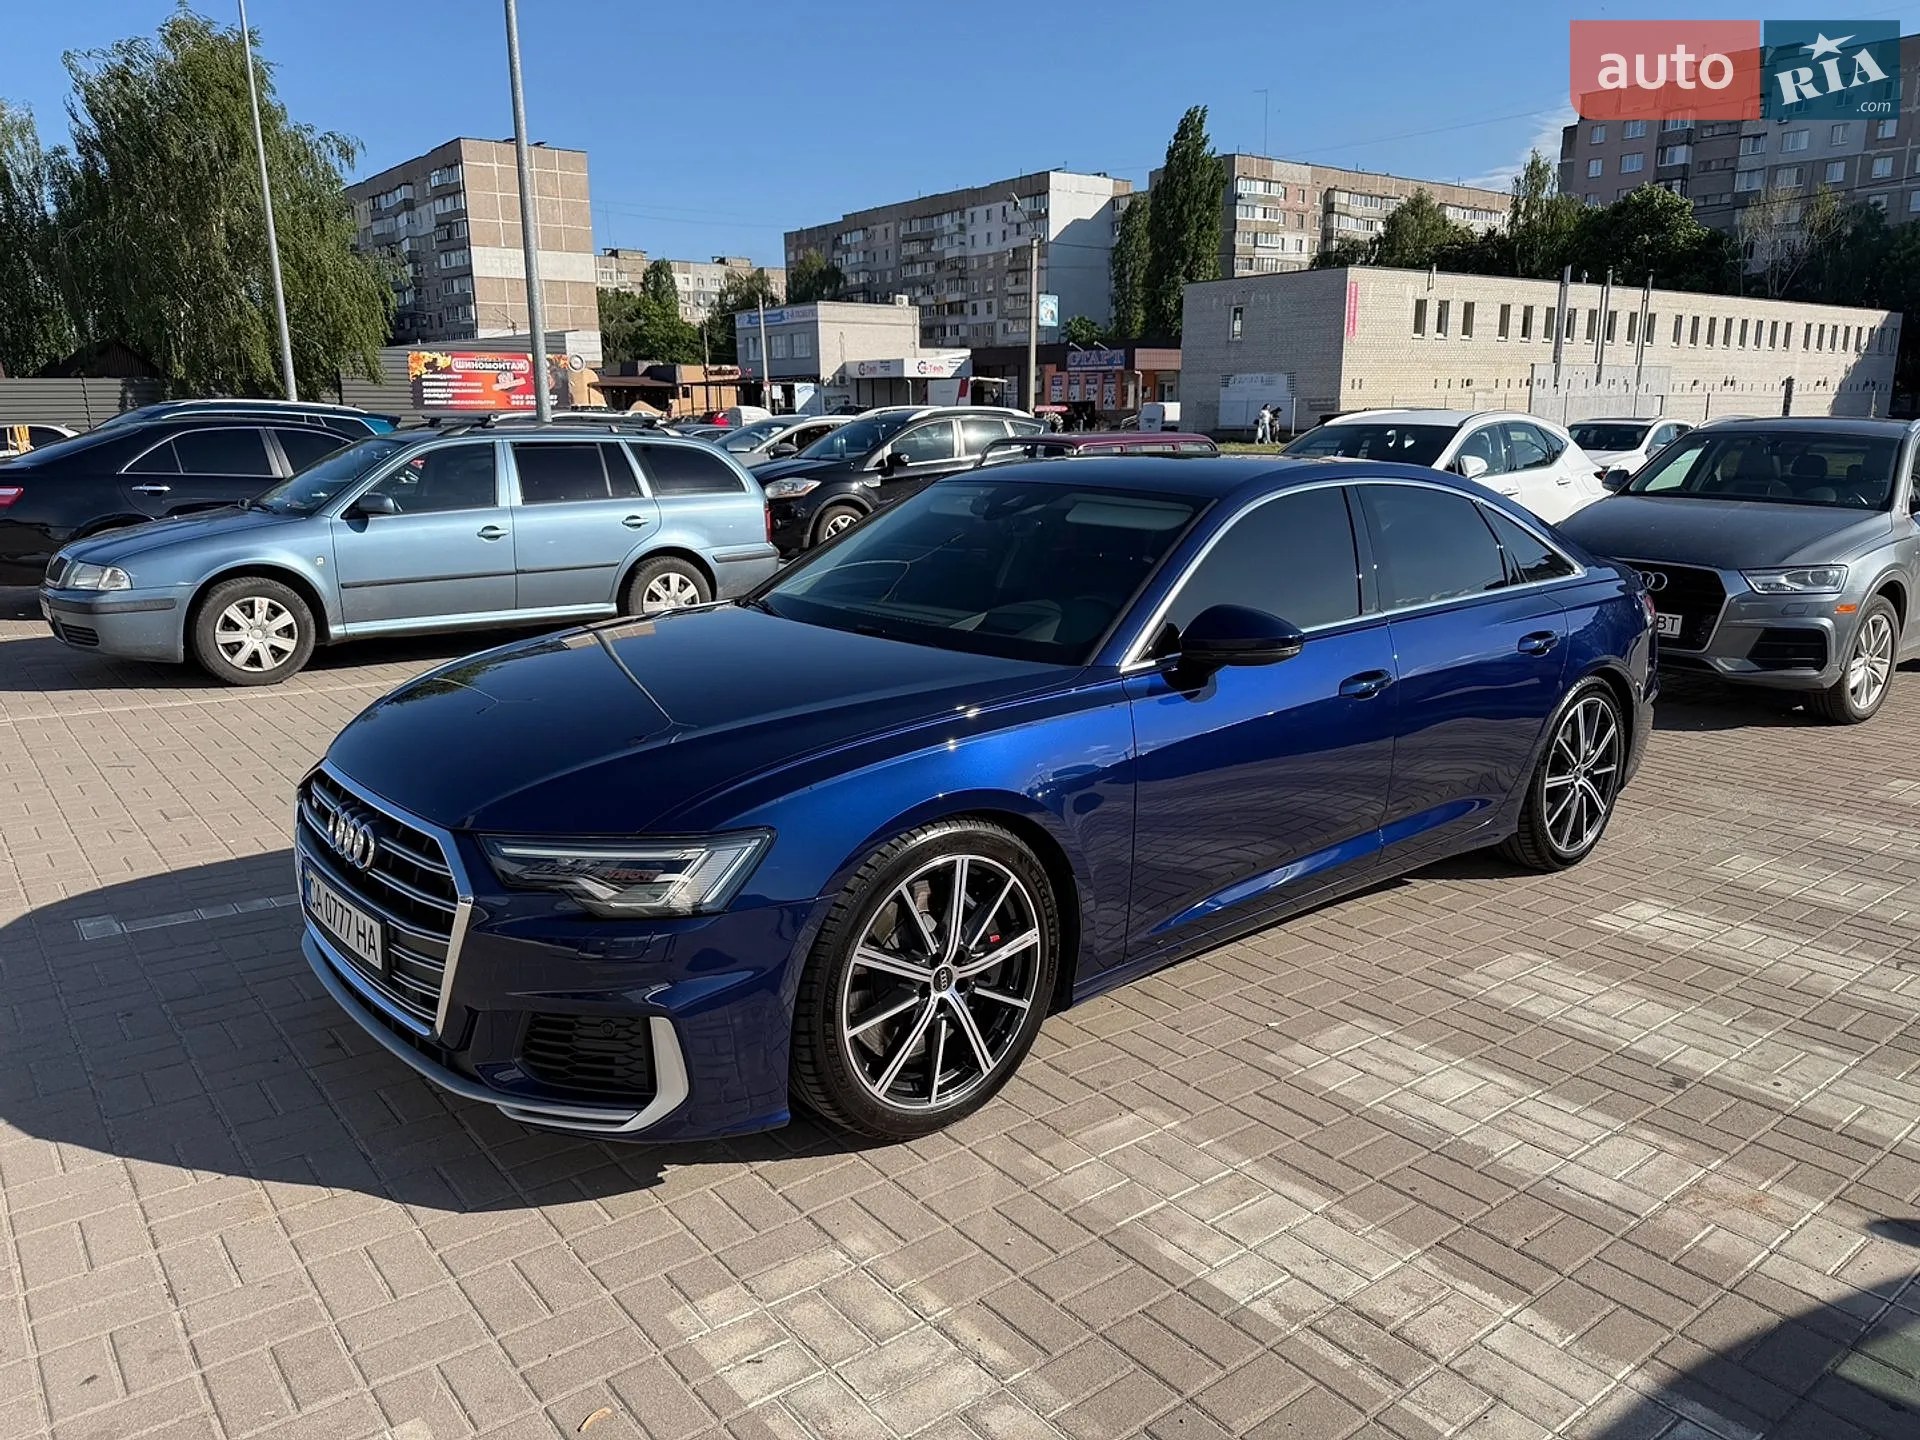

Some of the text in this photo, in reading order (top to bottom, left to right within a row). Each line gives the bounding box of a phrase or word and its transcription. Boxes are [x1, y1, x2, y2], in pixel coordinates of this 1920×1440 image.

[455, 360, 527, 371] ШИНОМОНТАЖ
[325, 892, 352, 939] 0777
[356, 915, 379, 961] HA
